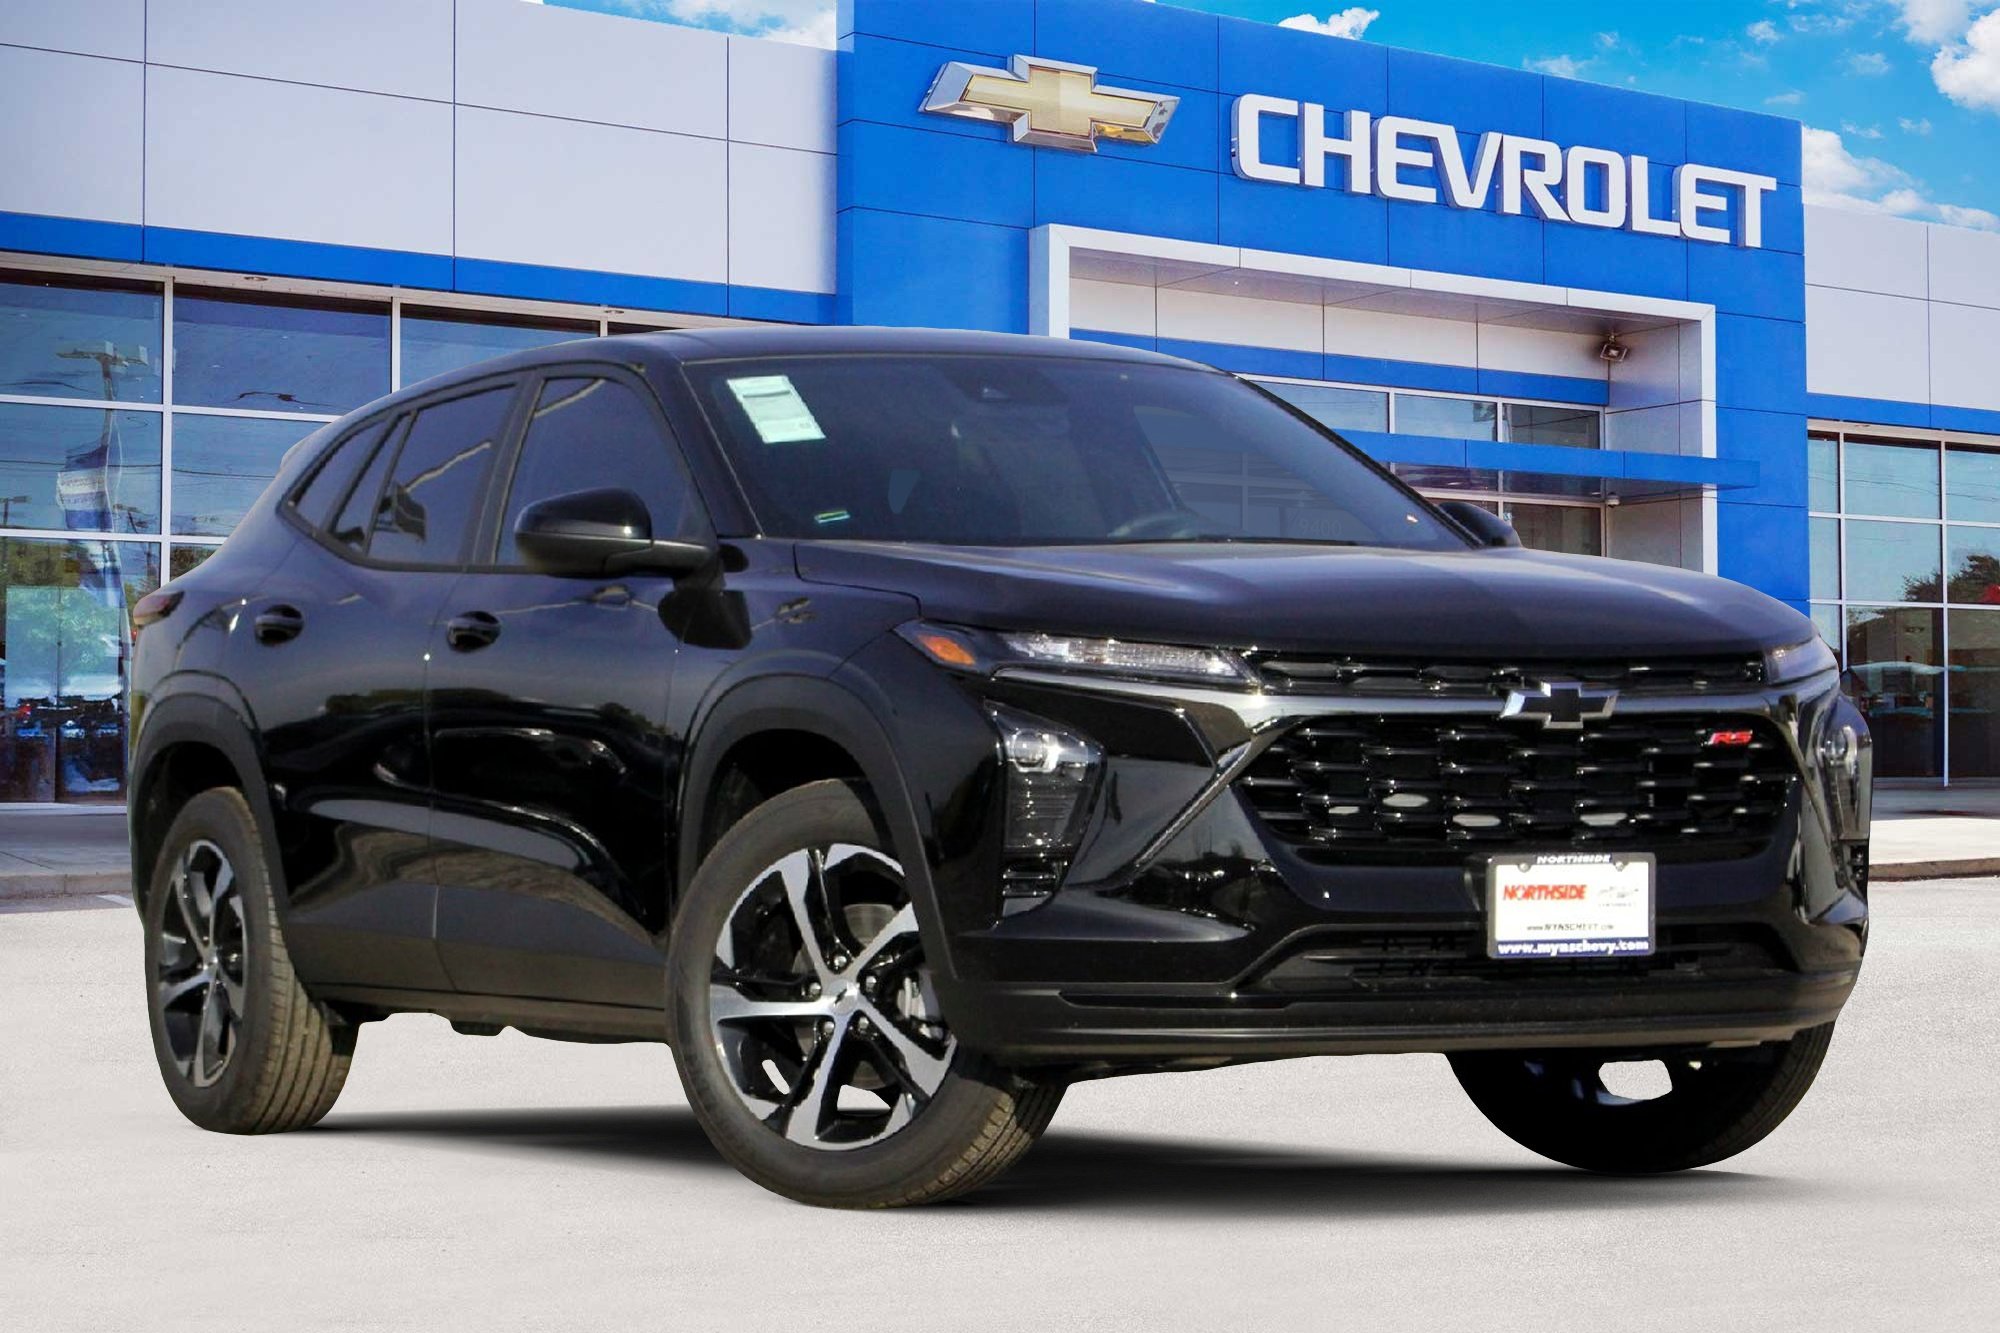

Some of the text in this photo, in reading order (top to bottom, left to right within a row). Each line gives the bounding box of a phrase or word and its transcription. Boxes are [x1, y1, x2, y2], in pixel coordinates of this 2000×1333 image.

[1231, 93, 1777, 248] CHEVROLET
[1708, 730, 1752, 745] RS
[1537, 854, 1611, 864] NORTHSIDE
[1503, 884, 1588, 900] NORTHSIDE
[1498, 939, 1649, 956] www.mynschevy.com
